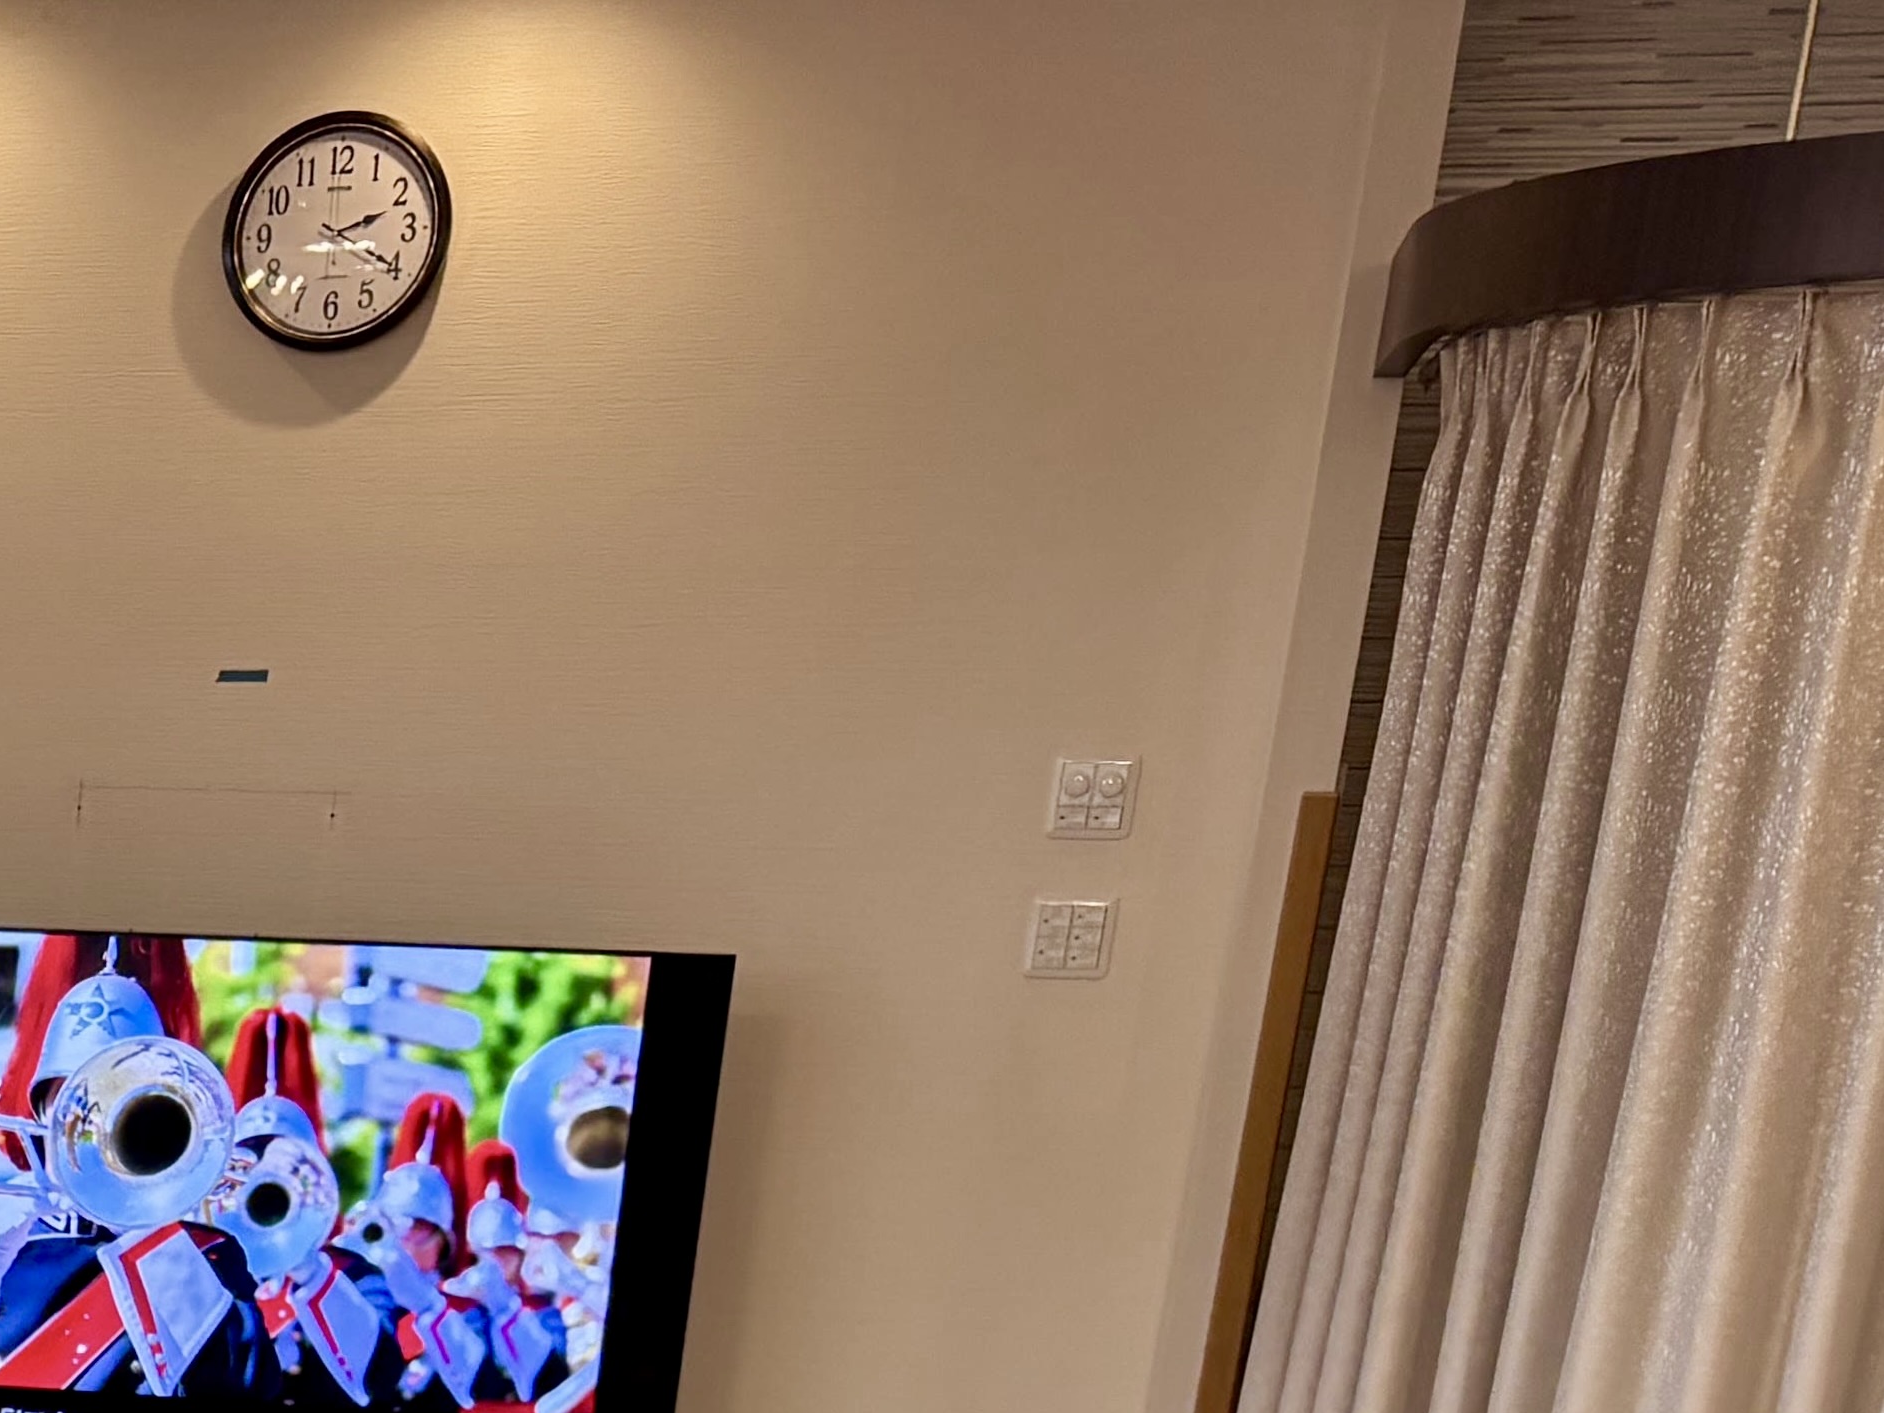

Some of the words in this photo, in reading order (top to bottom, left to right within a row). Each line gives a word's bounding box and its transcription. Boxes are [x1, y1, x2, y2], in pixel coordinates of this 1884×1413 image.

[296, 157, 316, 187] 11
[330, 145, 355, 175] 12
[372, 153, 381, 182] 1
[267, 185, 290, 216] 10
[392, 177, 409, 206] 2
[256, 223, 272, 253] 9
[401, 212, 417, 242] 3
[266, 258, 282, 288] 8
[387, 250, 402, 280] 4
[323, 290, 338, 320] 6
[357, 279, 375, 309] 5
